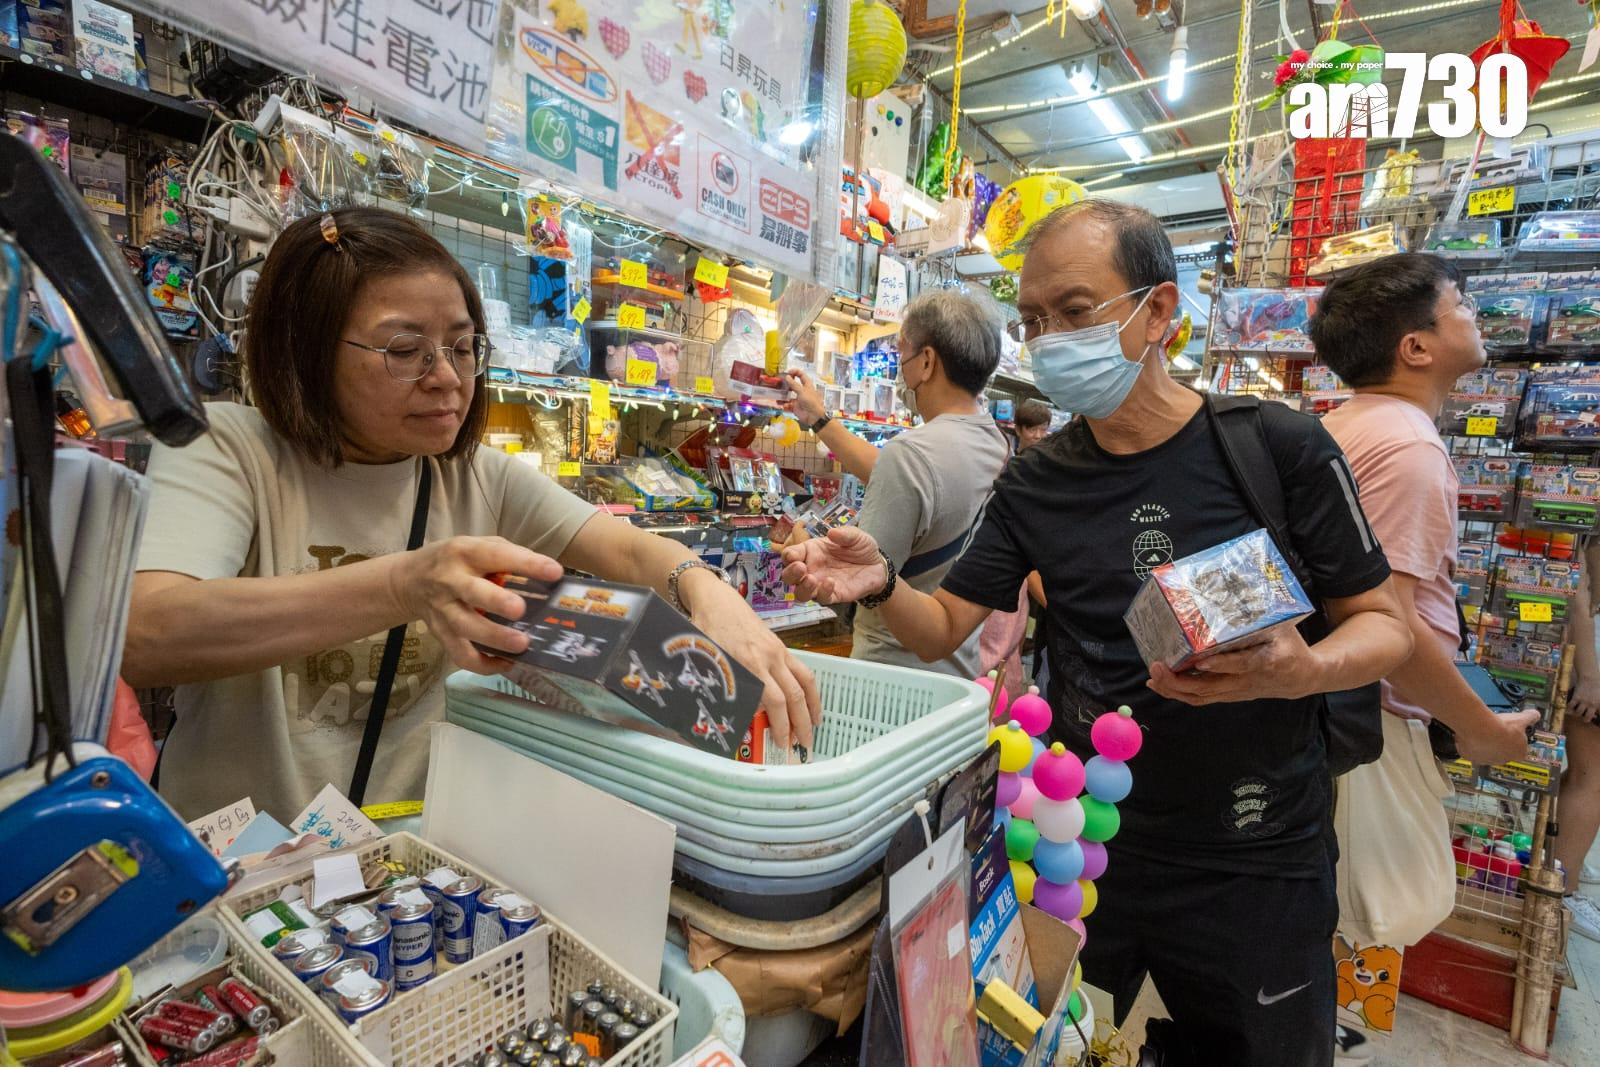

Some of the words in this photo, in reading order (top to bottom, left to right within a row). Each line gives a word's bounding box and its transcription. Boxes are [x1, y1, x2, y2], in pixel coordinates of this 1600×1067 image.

[720, 42, 781, 109] 日昇玩具
[702, 187, 725, 210] CASH
[726, 199, 747, 219] ONLY
[1139, 515, 1162, 523] WASTE
[1142, 503, 1170, 519] PLASTIC
[979, 866, 995, 893] Bostik
[970, 910, 997, 964] Blu-Tack
[406, 970, 414, 978] C
